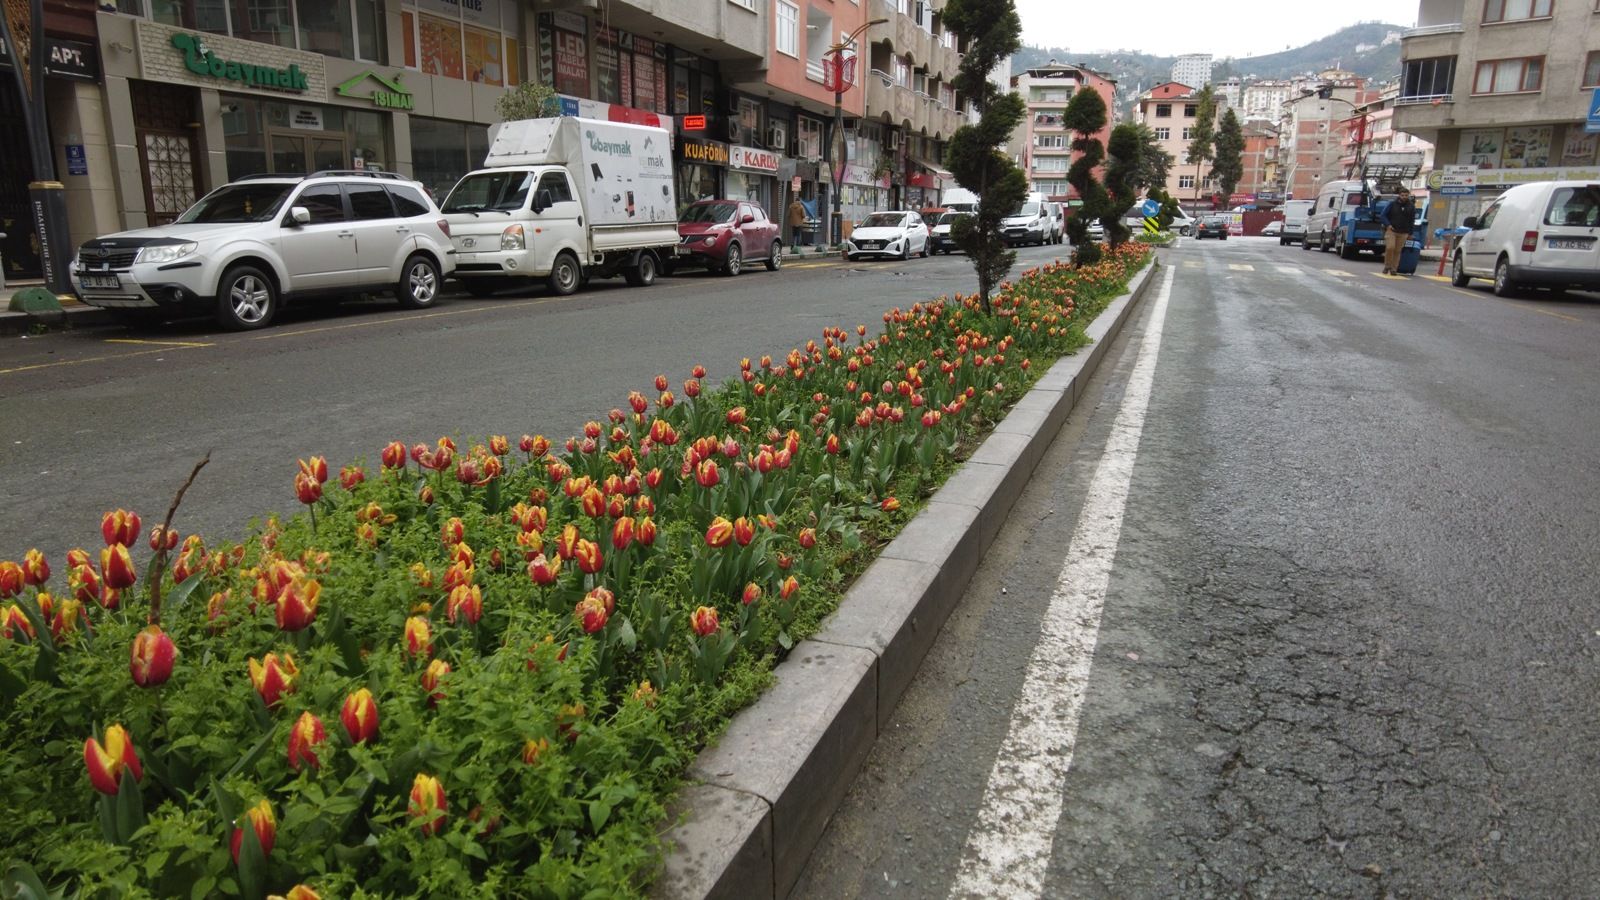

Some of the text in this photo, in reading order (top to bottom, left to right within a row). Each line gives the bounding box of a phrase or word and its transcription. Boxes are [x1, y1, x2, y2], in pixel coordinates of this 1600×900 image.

[556, 31, 586, 57] LED
[51, 46, 85, 67] APT.
[556, 52, 587, 68] TABELA
[208, 50, 308, 90] baymak
[597, 138, 632, 156] baymak
[685, 143, 728, 162] KUAFÖRÜM
